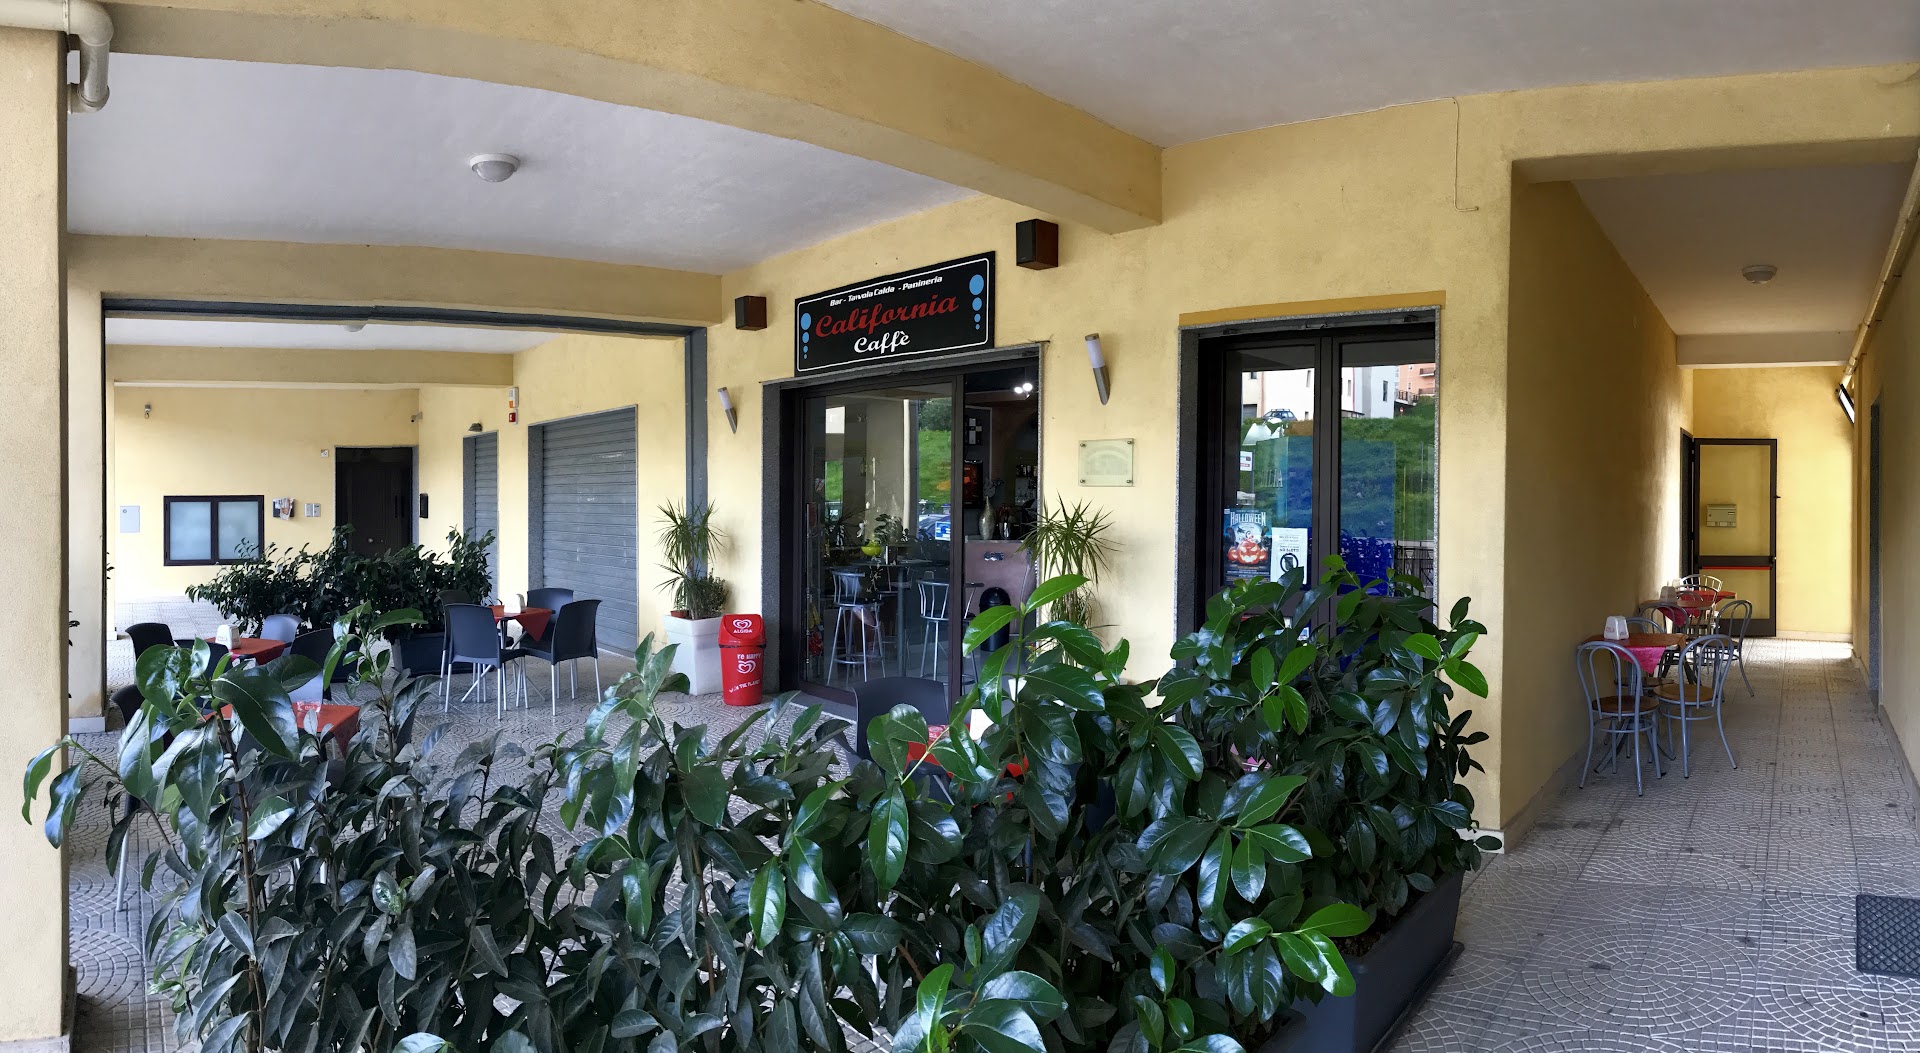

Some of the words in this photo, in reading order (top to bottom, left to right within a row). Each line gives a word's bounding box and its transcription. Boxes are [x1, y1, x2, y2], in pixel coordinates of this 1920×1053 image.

[830, 298, 843, 307] Bar
[848, 291, 874, 302] Tavola
[874, 285, 895, 297] Calda
[902, 276, 943, 291] Panineria
[815, 294, 959, 337] California
[854, 330, 910, 354] Caffè
[1230, 511, 1267, 526] HALLOWEEN
